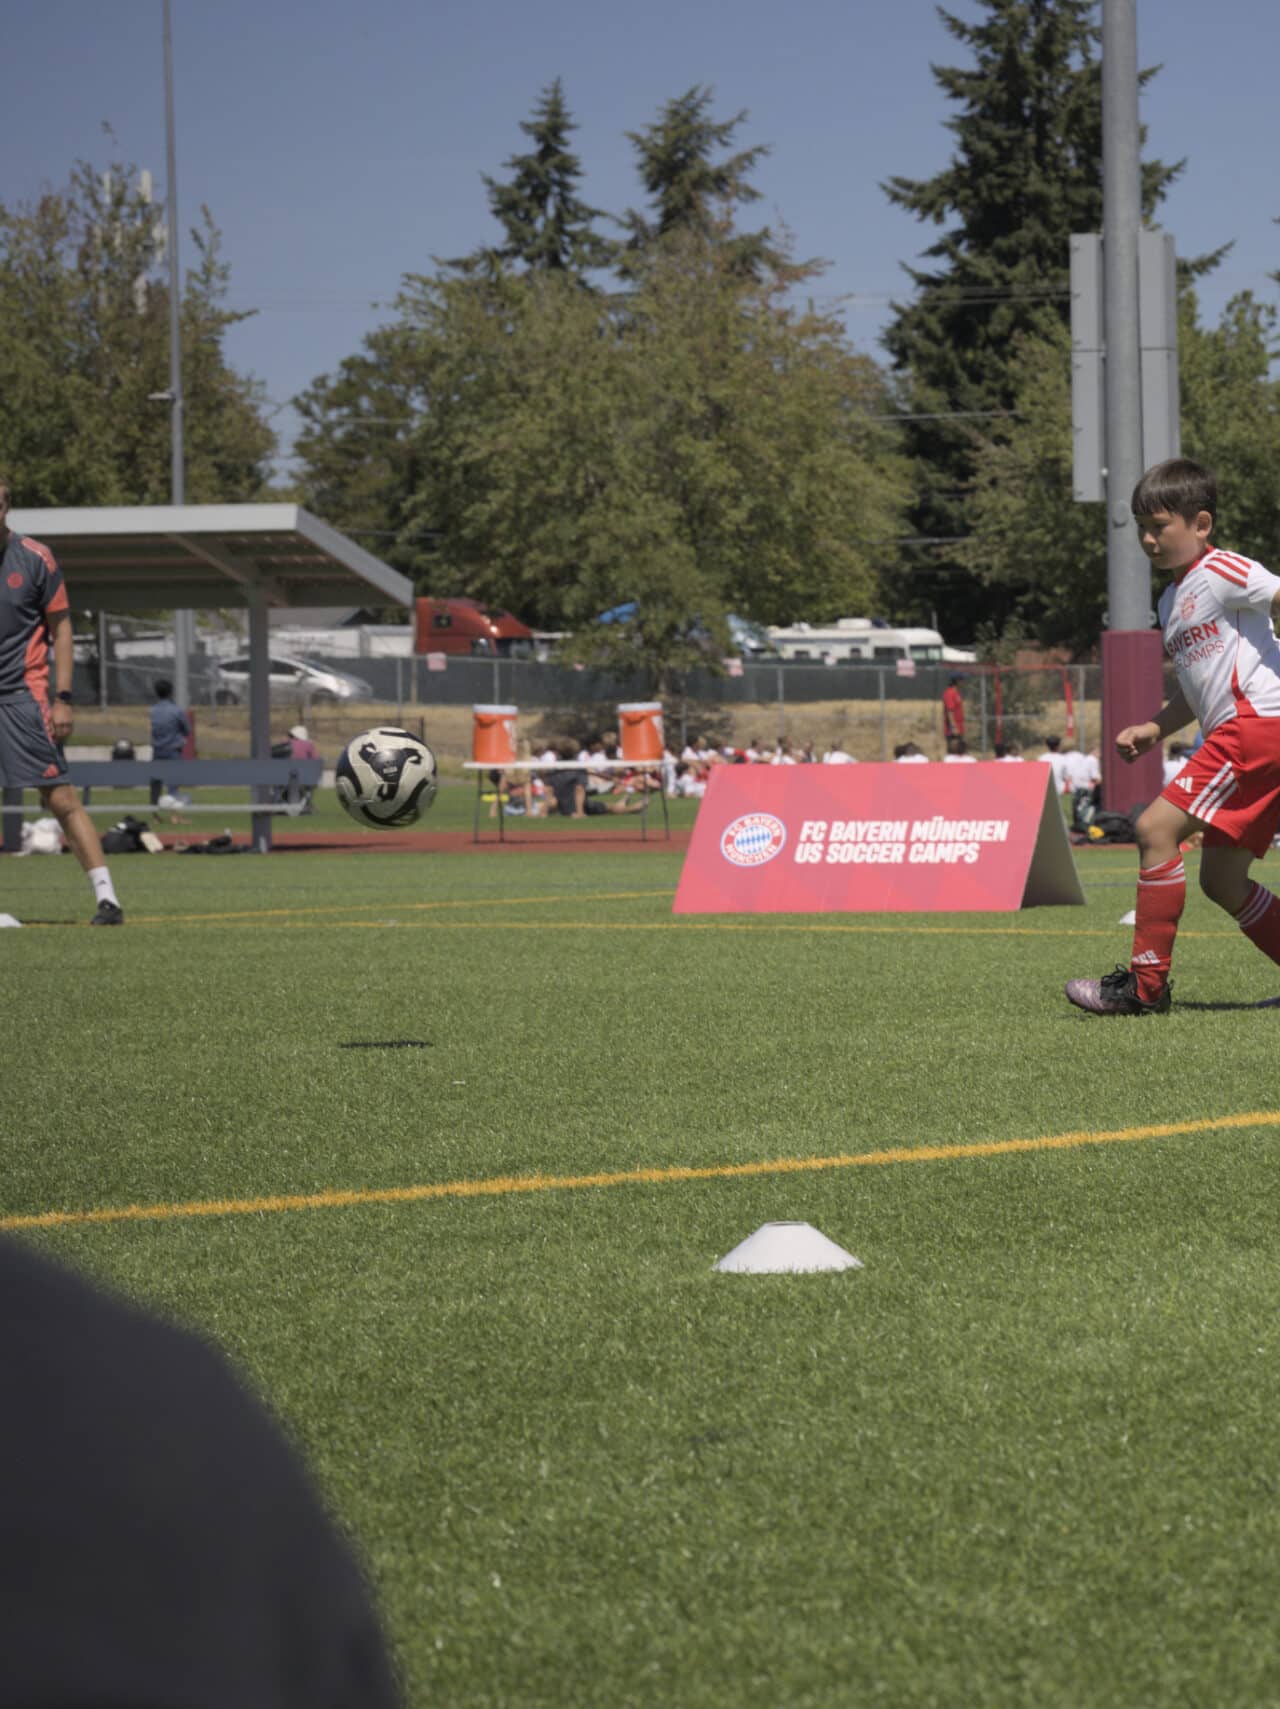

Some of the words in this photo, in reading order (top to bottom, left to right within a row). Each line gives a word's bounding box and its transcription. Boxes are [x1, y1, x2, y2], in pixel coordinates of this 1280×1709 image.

[1184, 640, 1225, 668] CAMPS
[799, 820, 828, 842] FC
[828, 820, 908, 842] BAYERN
[910, 815, 1010, 842] MÜNCHEN
[794, 842, 824, 863] US
[825, 842, 906, 863] SOCCER
[908, 842, 981, 863] CAMPS
